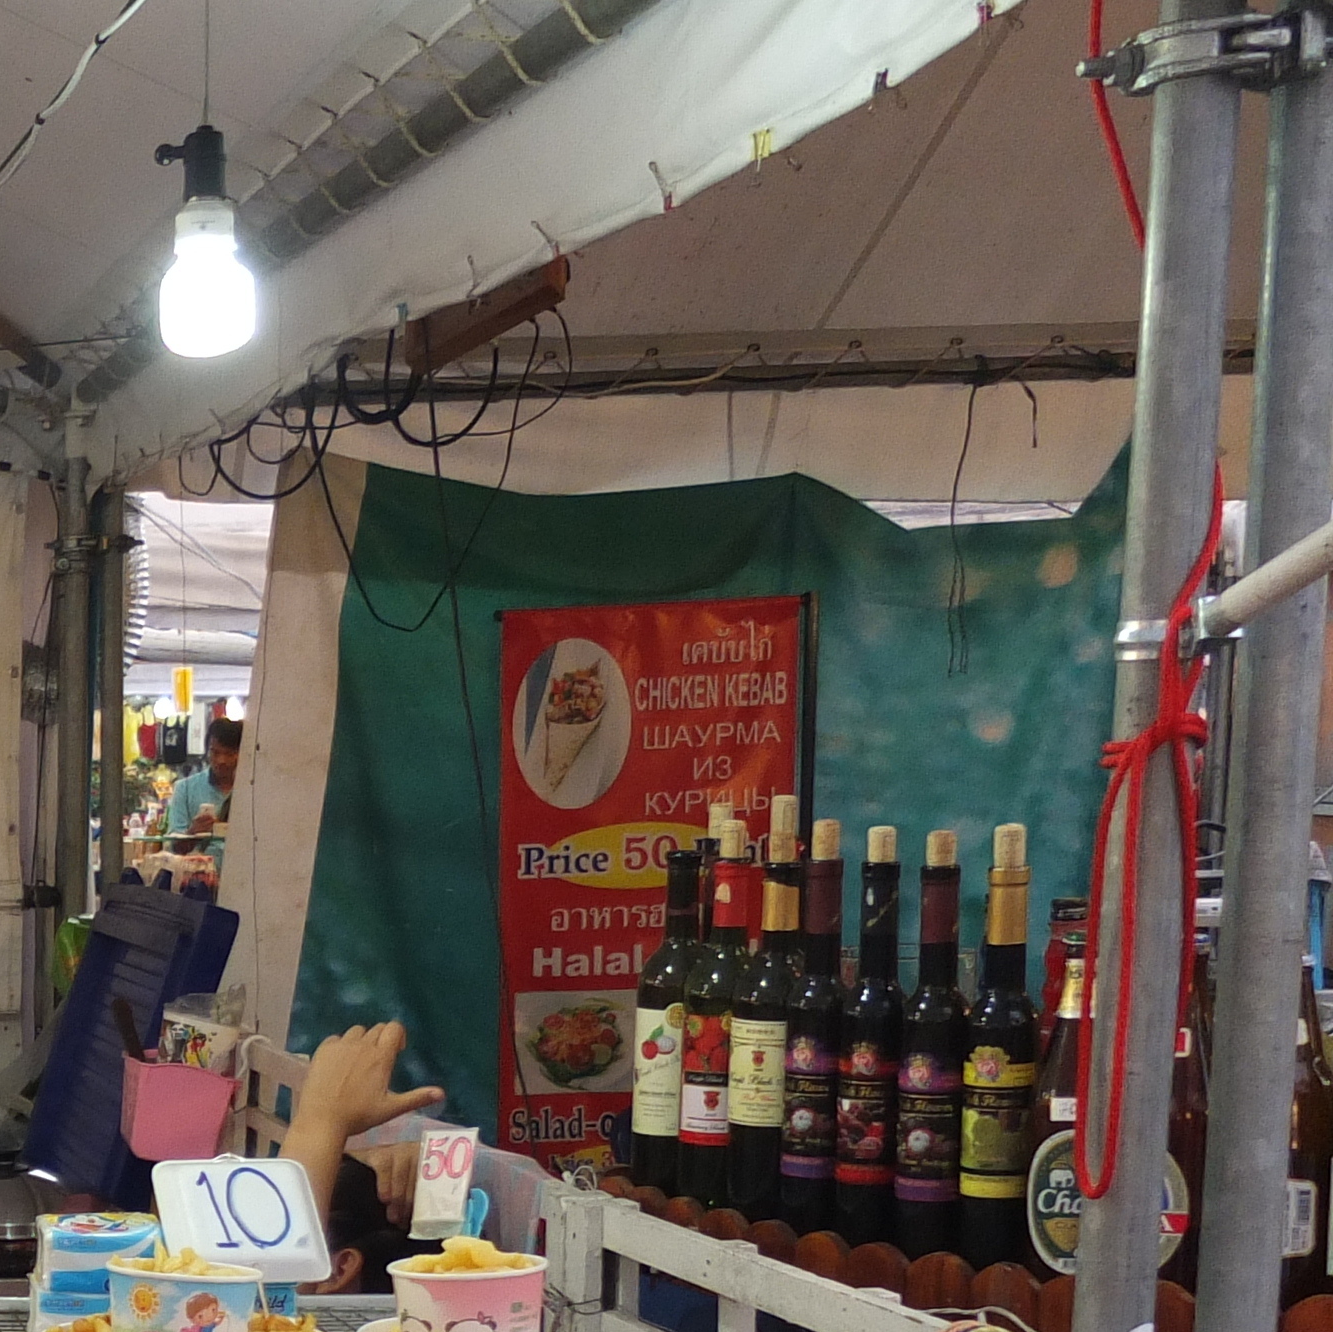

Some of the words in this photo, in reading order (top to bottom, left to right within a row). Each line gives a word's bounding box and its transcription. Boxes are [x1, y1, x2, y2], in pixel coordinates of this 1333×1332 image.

[634, 673, 719, 712] CHICKEN
[724, 670, 788, 708] KEBAB
[642, 719, 782, 750] ШАУРМА
[693, 754, 733, 781] ИЗ
[519, 843, 610, 879] Price
[532, 943, 644, 979] Halal
[422, 1135, 474, 1180] 50
[195, 1166, 291, 1249] 10
